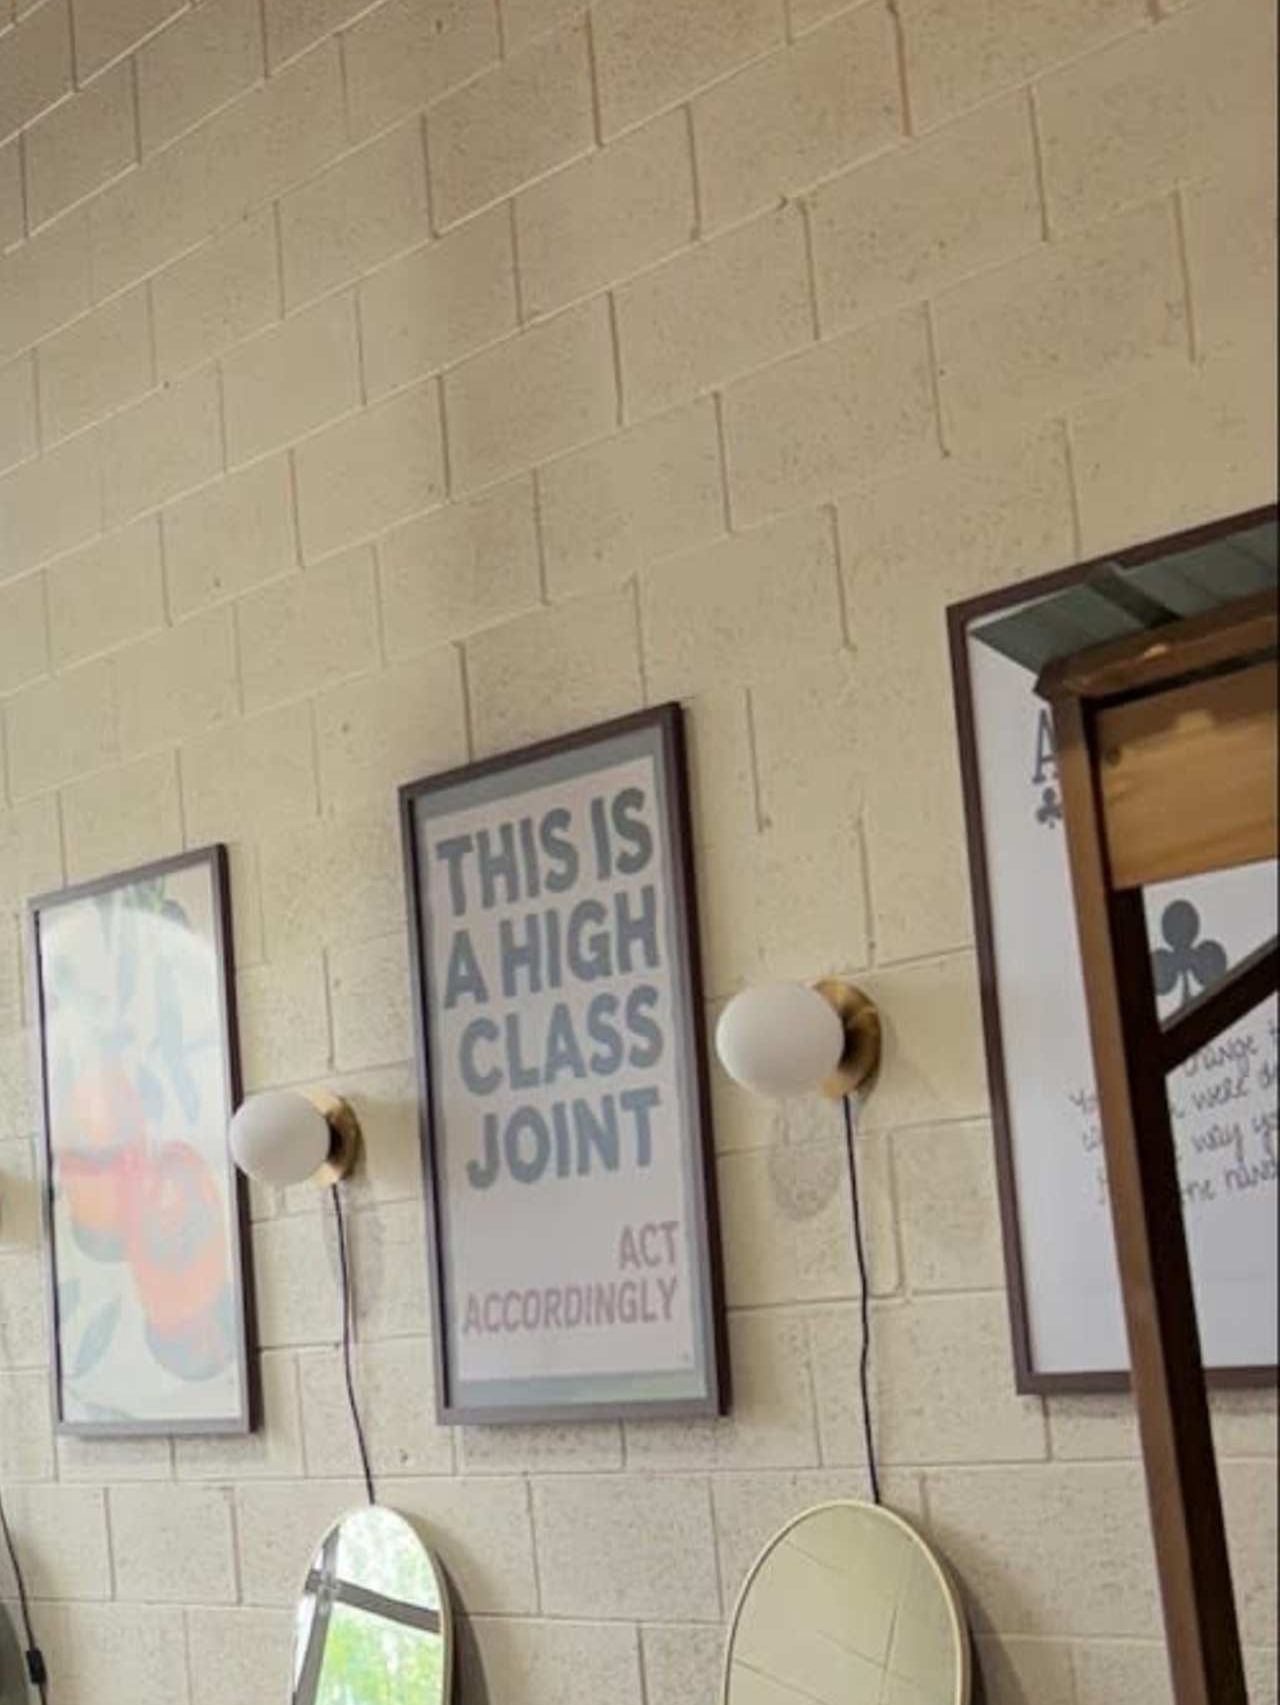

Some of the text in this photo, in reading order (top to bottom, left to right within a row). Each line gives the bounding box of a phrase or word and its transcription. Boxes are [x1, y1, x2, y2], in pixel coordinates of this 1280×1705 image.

[436, 788, 654, 917] THIS IS
[444, 885, 660, 1009] A HIGH
[459, 984, 664, 1095] CLASS
[467, 1087, 661, 1189] JOINT
[619, 1220, 680, 1270] ACT
[464, 1276, 678, 1335] ACCORDINGLY
